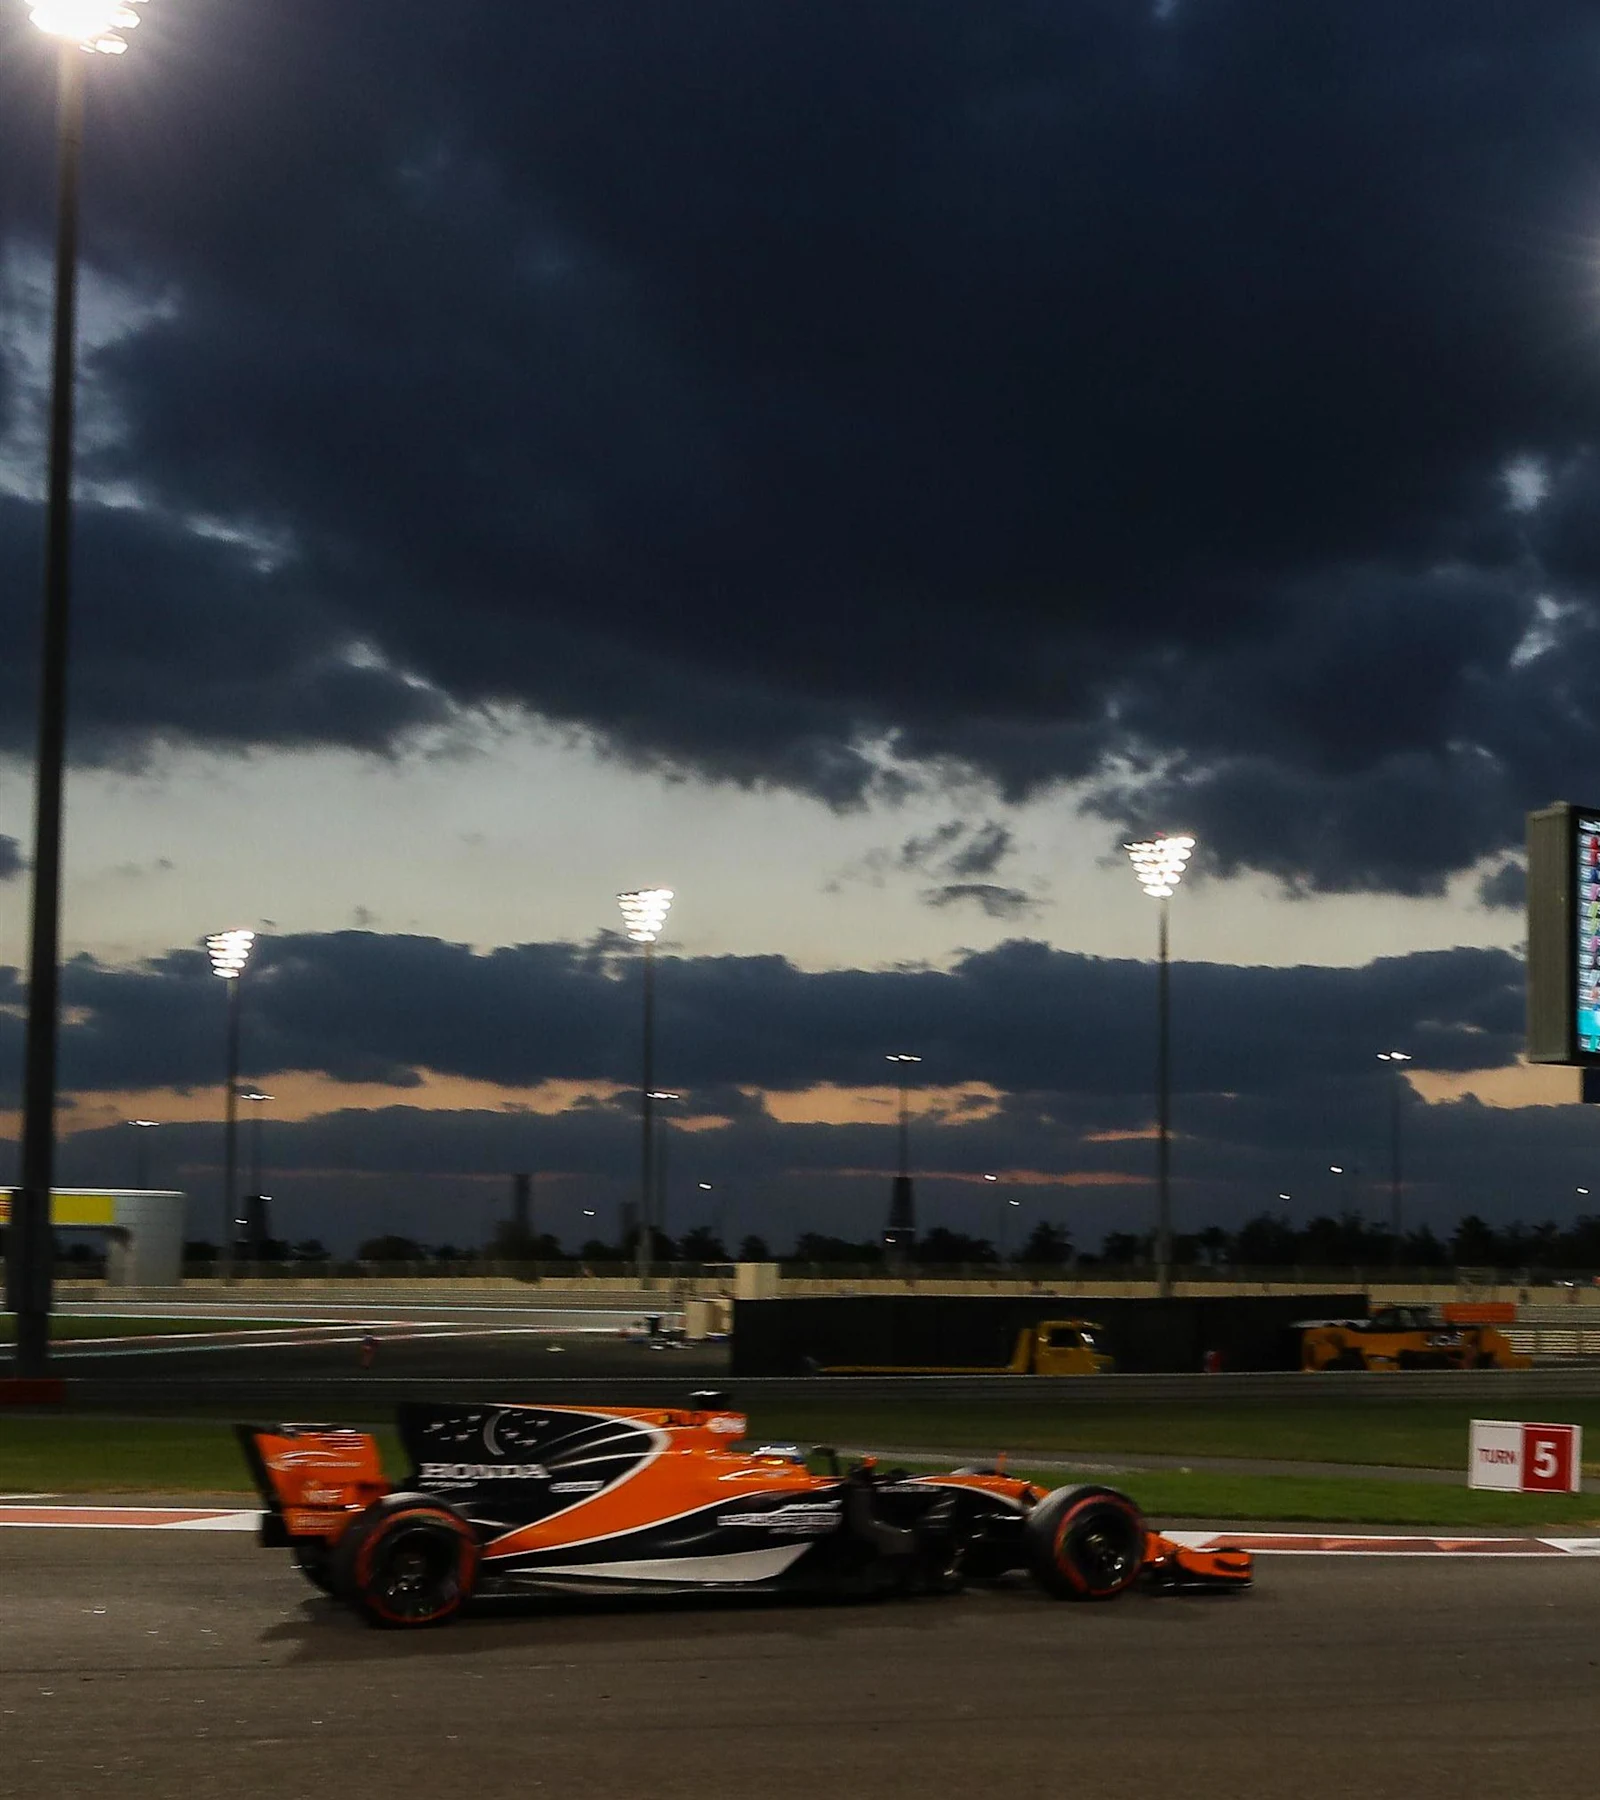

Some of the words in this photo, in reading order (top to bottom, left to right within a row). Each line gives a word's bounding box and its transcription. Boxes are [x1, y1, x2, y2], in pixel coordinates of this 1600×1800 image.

[418, 1462, 553, 1479] HONDA
[1477, 1448, 1517, 1465] TURN
[1532, 1440, 1559, 1479] 5
